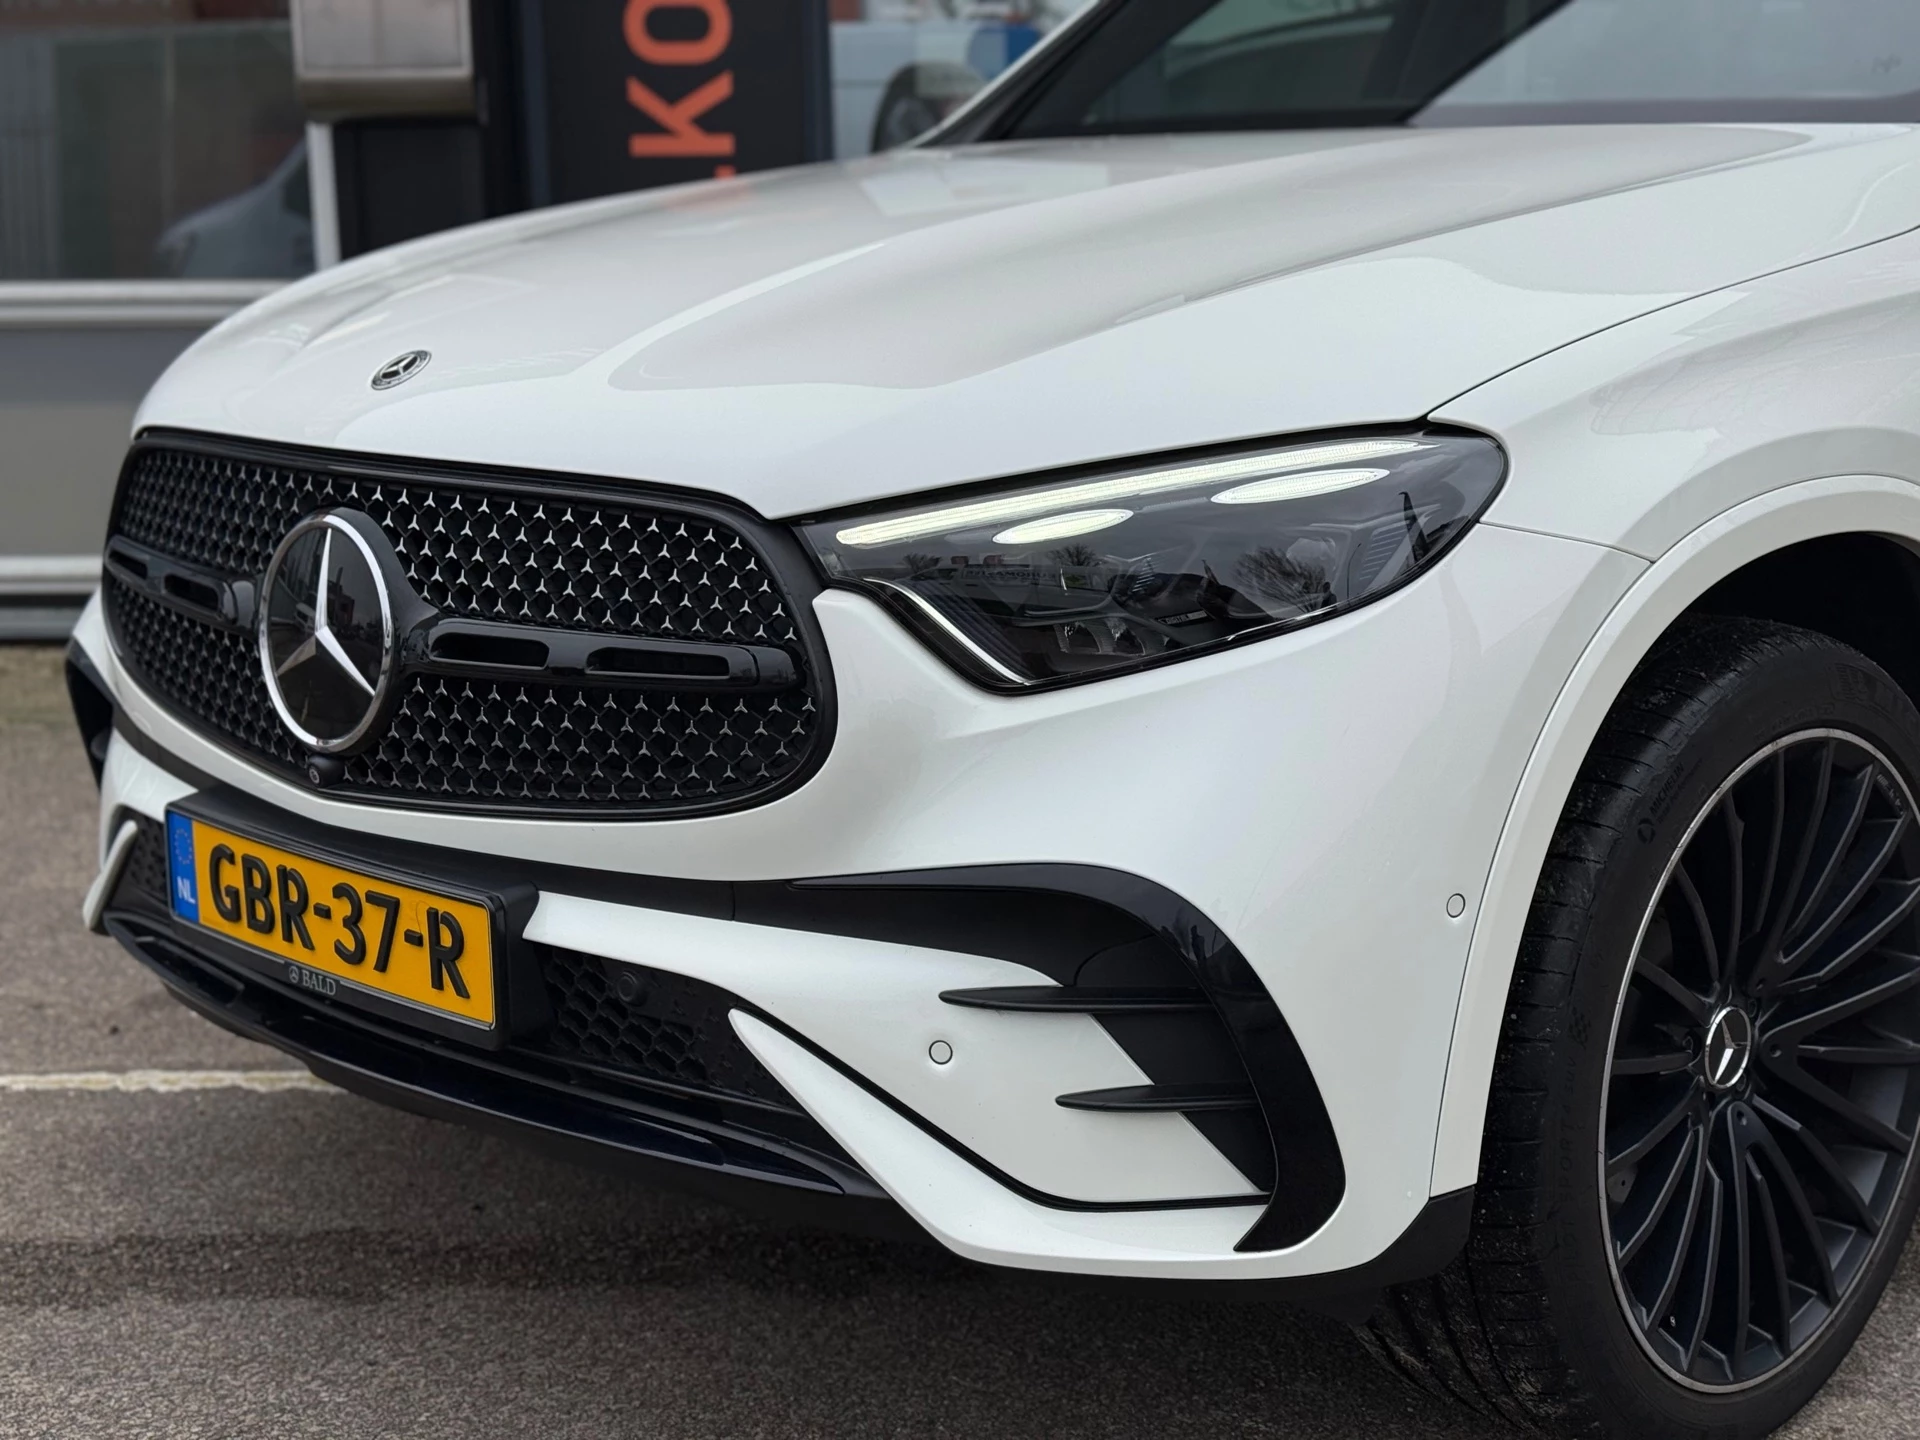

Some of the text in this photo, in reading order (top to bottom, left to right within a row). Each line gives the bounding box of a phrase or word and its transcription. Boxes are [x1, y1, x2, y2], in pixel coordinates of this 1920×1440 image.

[623, 0, 736, 179] KO
[1649, 761, 1684, 818] MICHELIN
[177, 874, 196, 905] NL
[208, 842, 470, 999] GBR-37-R
[301, 969, 336, 996] BALD
[1562, 1055, 1577, 1096] SUV
[1559, 1117, 1576, 1203] SPORT
